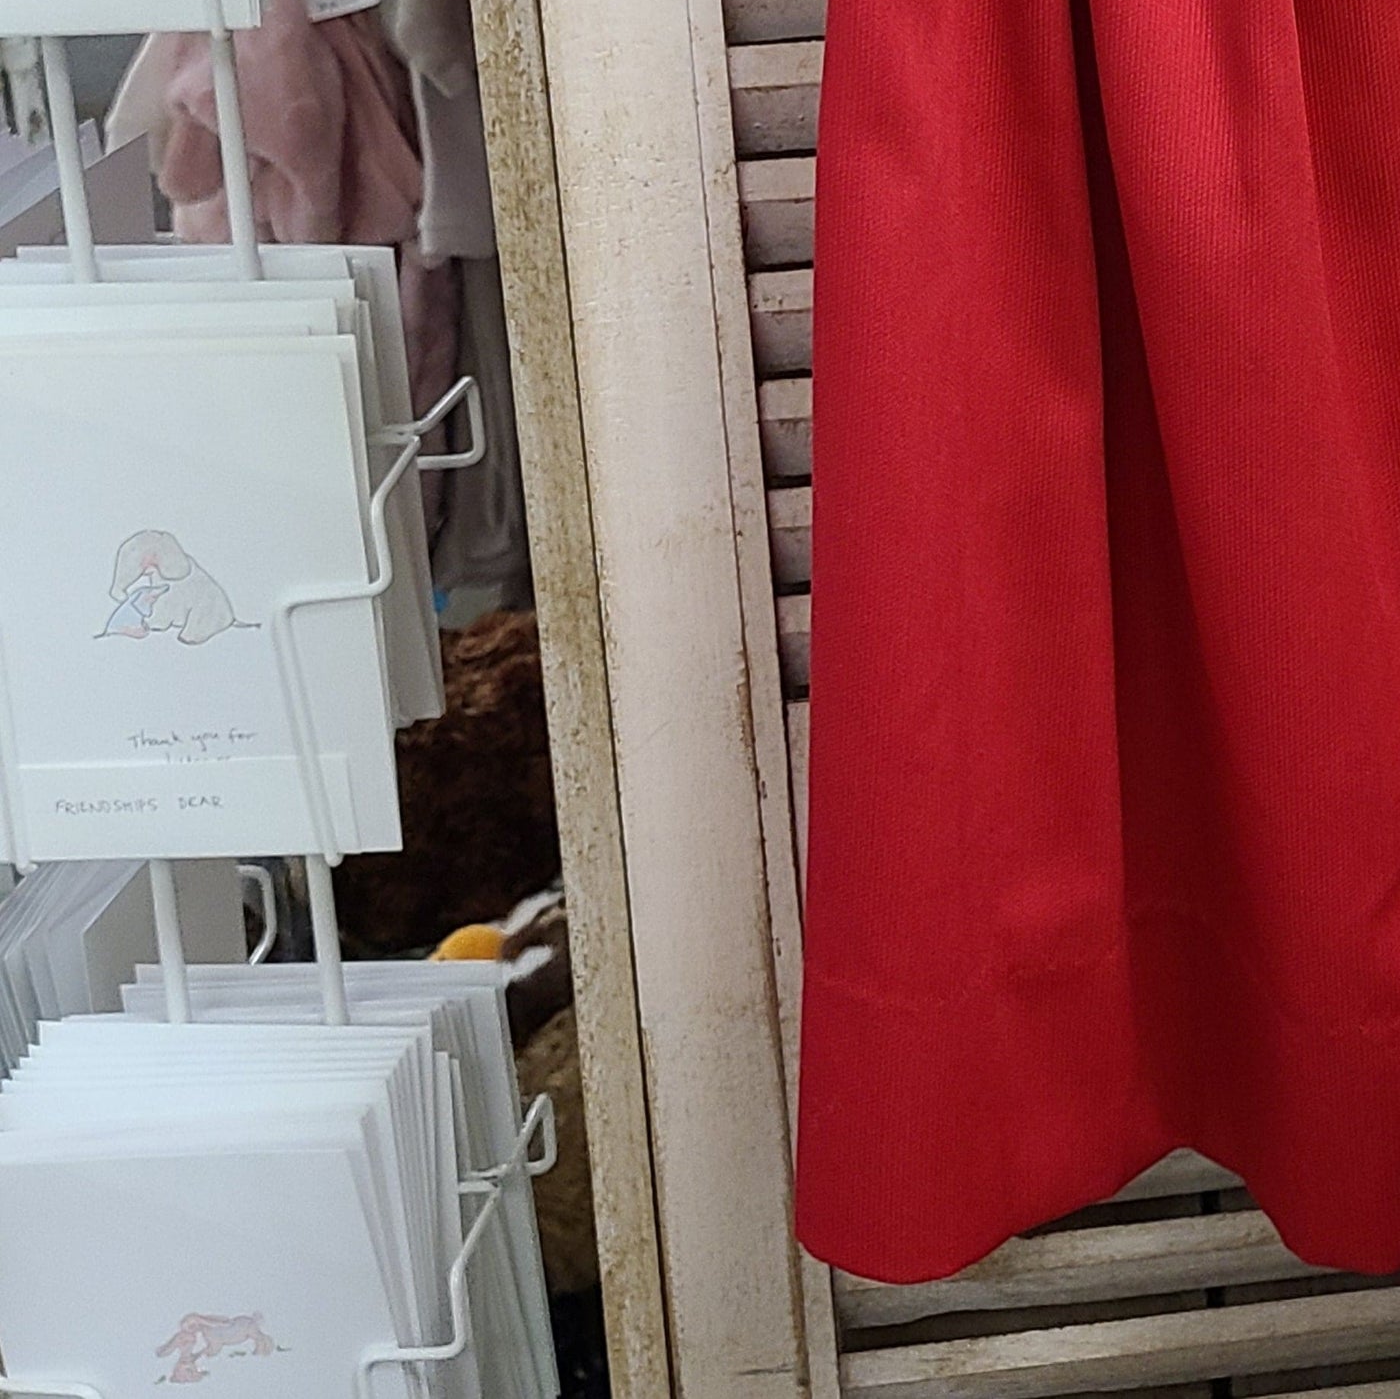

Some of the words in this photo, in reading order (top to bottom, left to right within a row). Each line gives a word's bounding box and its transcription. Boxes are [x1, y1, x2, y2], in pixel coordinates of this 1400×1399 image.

[128, 729, 183, 748] Thank
[192, 732, 219, 751] you
[228, 727, 257, 743] for
[56, 799, 157, 815] FRIENDSHIPS
[178, 795, 223, 810] DEAR
